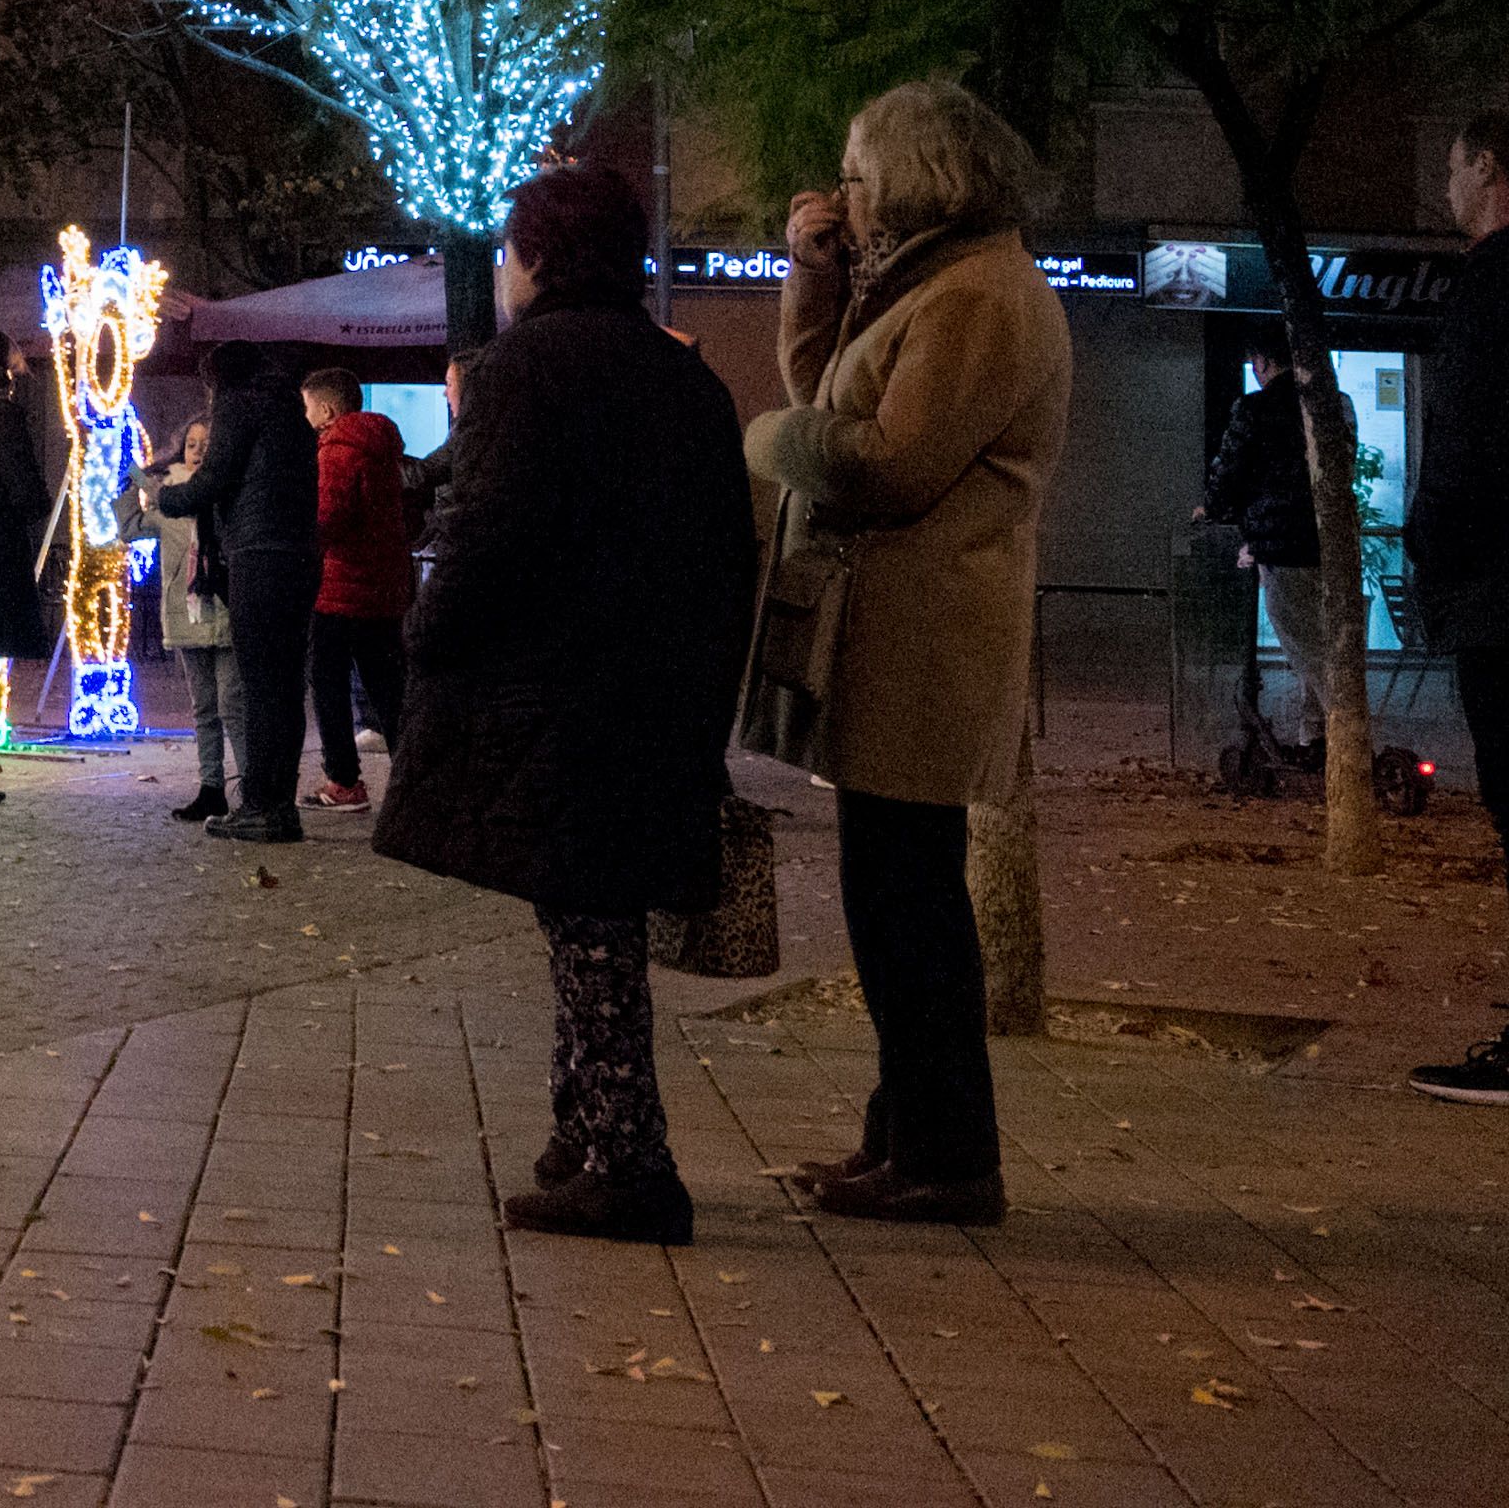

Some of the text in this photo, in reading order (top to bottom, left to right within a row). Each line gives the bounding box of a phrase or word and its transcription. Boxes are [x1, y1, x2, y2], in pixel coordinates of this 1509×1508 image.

[707, 250, 791, 278] Pedic
[1042, 256, 1060, 270] de
[1061, 257, 1083, 274] gel
[1080, 274, 1136, 289] Pedicura
[356, 325, 412, 334] ESTRELLA
